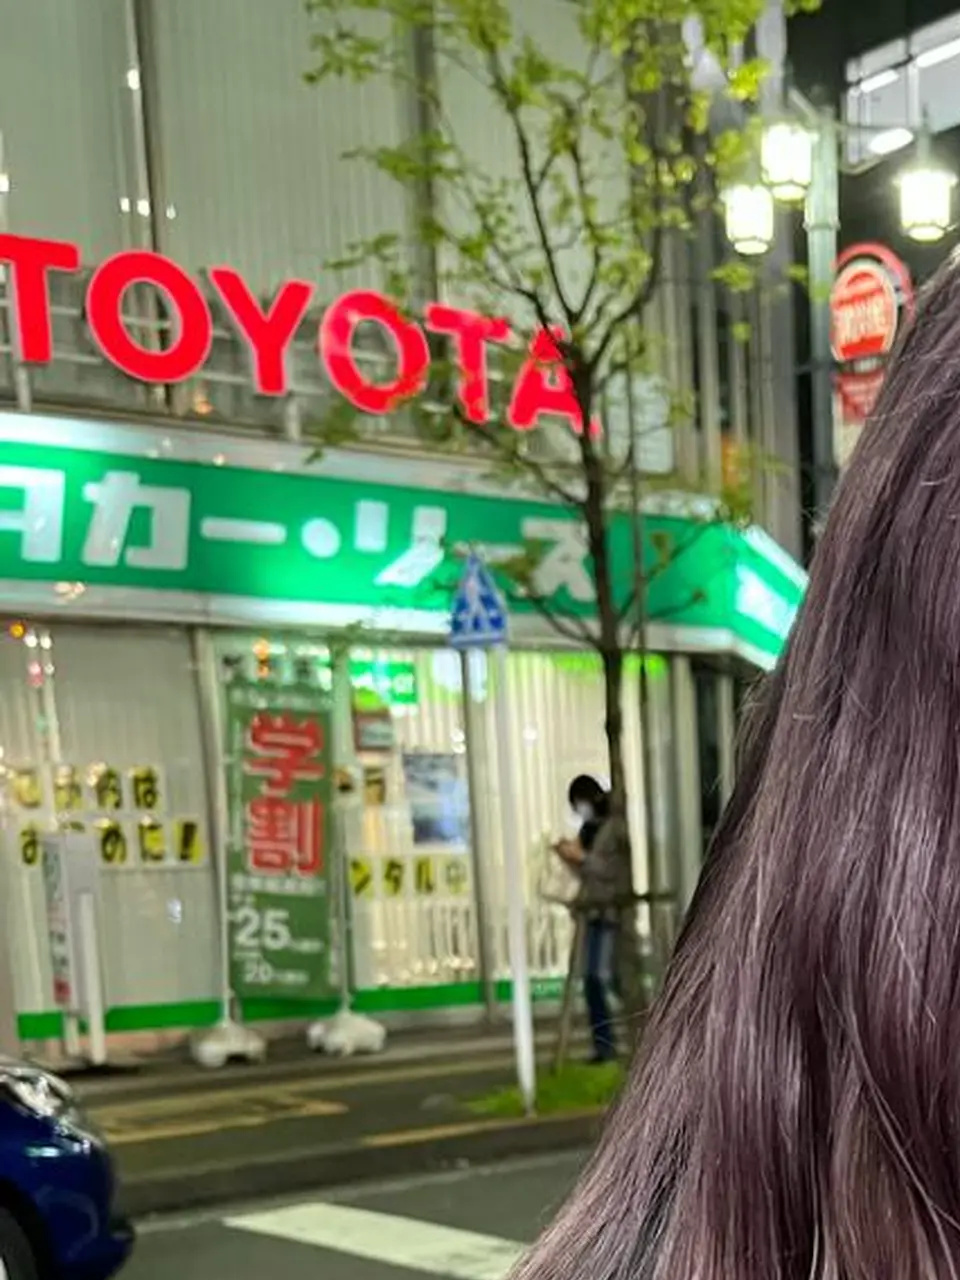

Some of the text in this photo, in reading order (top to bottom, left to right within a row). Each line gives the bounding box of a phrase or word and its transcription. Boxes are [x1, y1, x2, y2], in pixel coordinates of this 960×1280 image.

[0, 232, 602, 440] TOYOTA
[246, 710, 324, 876] 学割
[235, 906, 291, 951] 25
